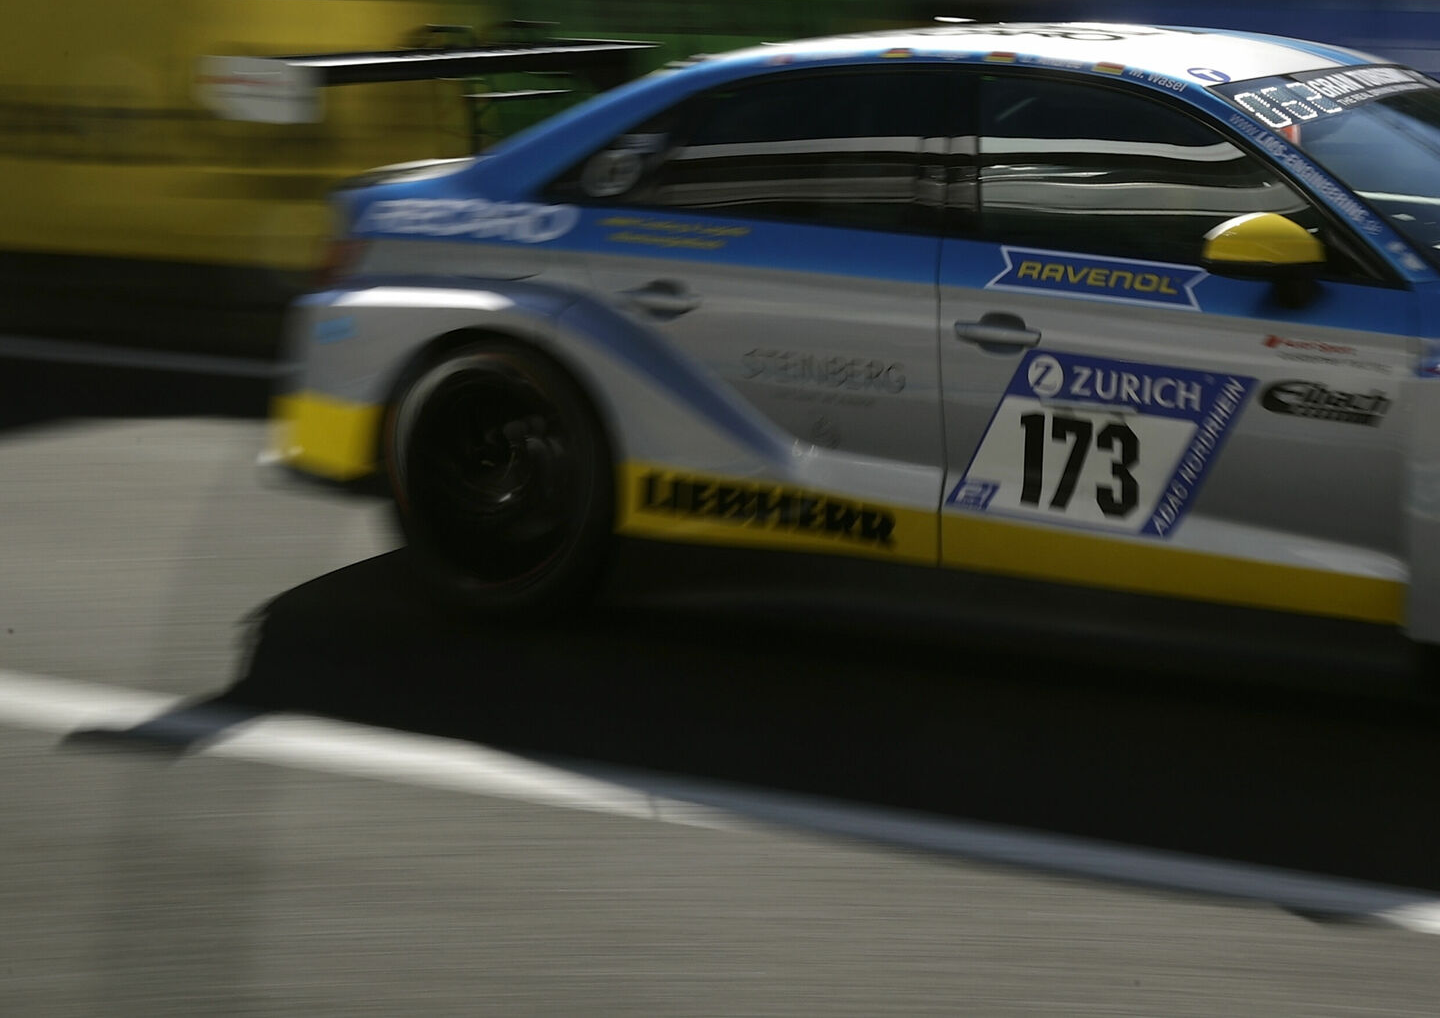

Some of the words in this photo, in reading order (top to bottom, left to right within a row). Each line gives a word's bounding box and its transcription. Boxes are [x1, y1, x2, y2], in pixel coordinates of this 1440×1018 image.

[1147, 70, 1187, 93] Wasel
[1308, 73, 1363, 99] GRAN
[1017, 261, 1178, 295] RAVENOL
[1070, 365, 1203, 412] ZURICH
[1020, 413, 1140, 520] 173
[1151, 482, 1189, 537] ADAC
[1178, 376, 1246, 486] NORDRHEIN
[638, 471, 896, 549] LIEBHERR
